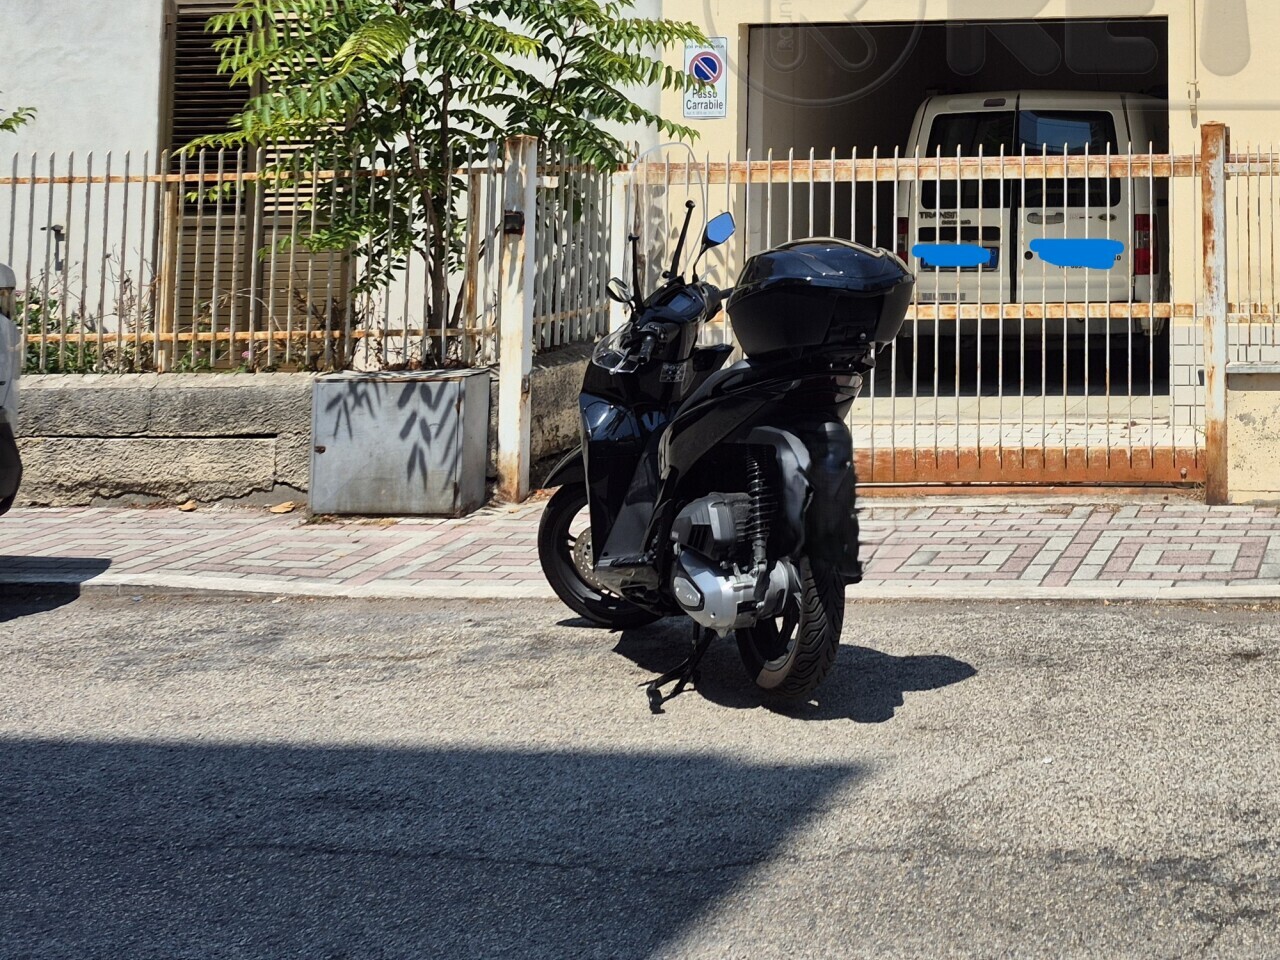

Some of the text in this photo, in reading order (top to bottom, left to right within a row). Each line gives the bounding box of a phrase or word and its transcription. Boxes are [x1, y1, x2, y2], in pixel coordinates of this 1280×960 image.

[692, 88, 718, 99] Passo
[686, 99, 724, 110] Carrabile
[919, 211, 959, 219] TRANSIT
